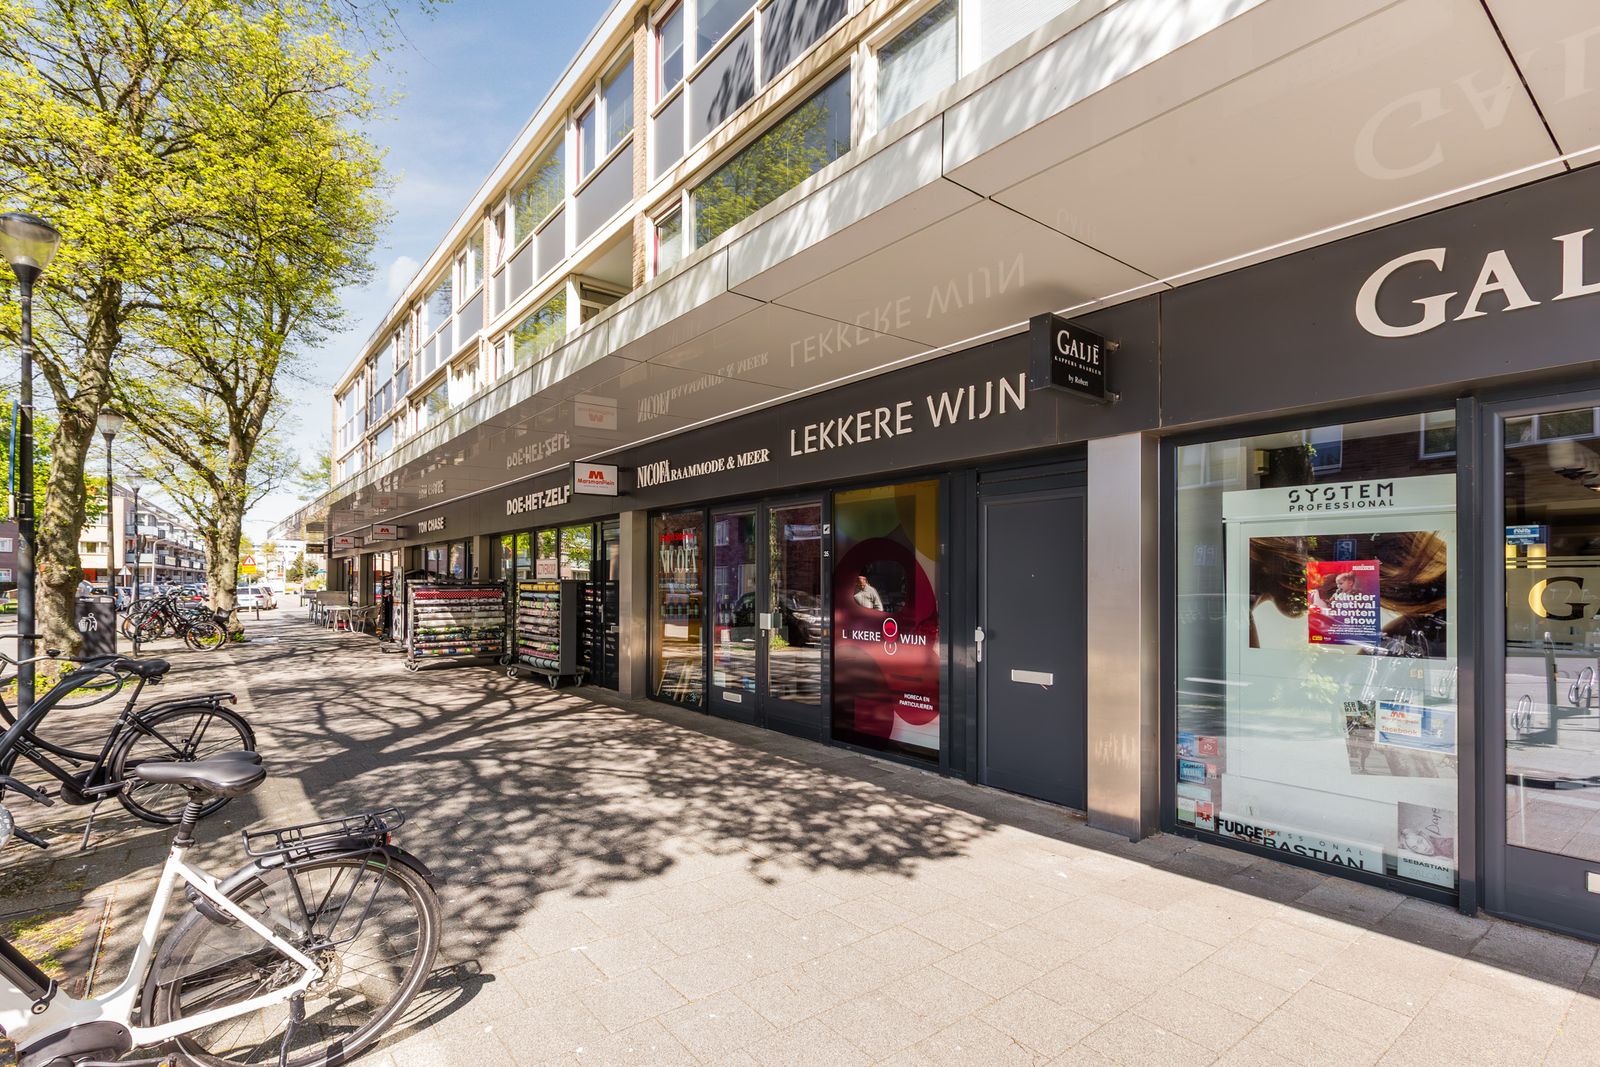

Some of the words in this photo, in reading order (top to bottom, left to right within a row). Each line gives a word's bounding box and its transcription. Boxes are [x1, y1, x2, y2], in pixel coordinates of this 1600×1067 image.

[790, 400, 913, 457] LEKKERE
[926, 372, 1026, 428] WIJN
[637, 459, 671, 489] NICOFA
[671, 458, 725, 482] RAAMMODE
[726, 456, 736, 470] &
[737, 448, 771, 468] MEER
[1288, 482, 1394, 503] SYSTEM
[1288, 499, 1395, 513] PROFESSIONAL
[1334, 592, 1376, 601] Kinder
[1528, 576, 1600, 620] G
[1330, 600, 1376, 609] festival
[1321, 608, 1376, 617] Talenten
[1343, 617, 1377, 625] show
[842, 629, 881, 642] LKKERE
[900, 633, 927, 646] WIJN
[903, 693, 922, 702] HORECA
[899, 699, 934, 711] PARTICULIEREN
[1217, 819, 1264, 839] FUDGE
[1402, 858, 1449, 873] SEBASTIAN
